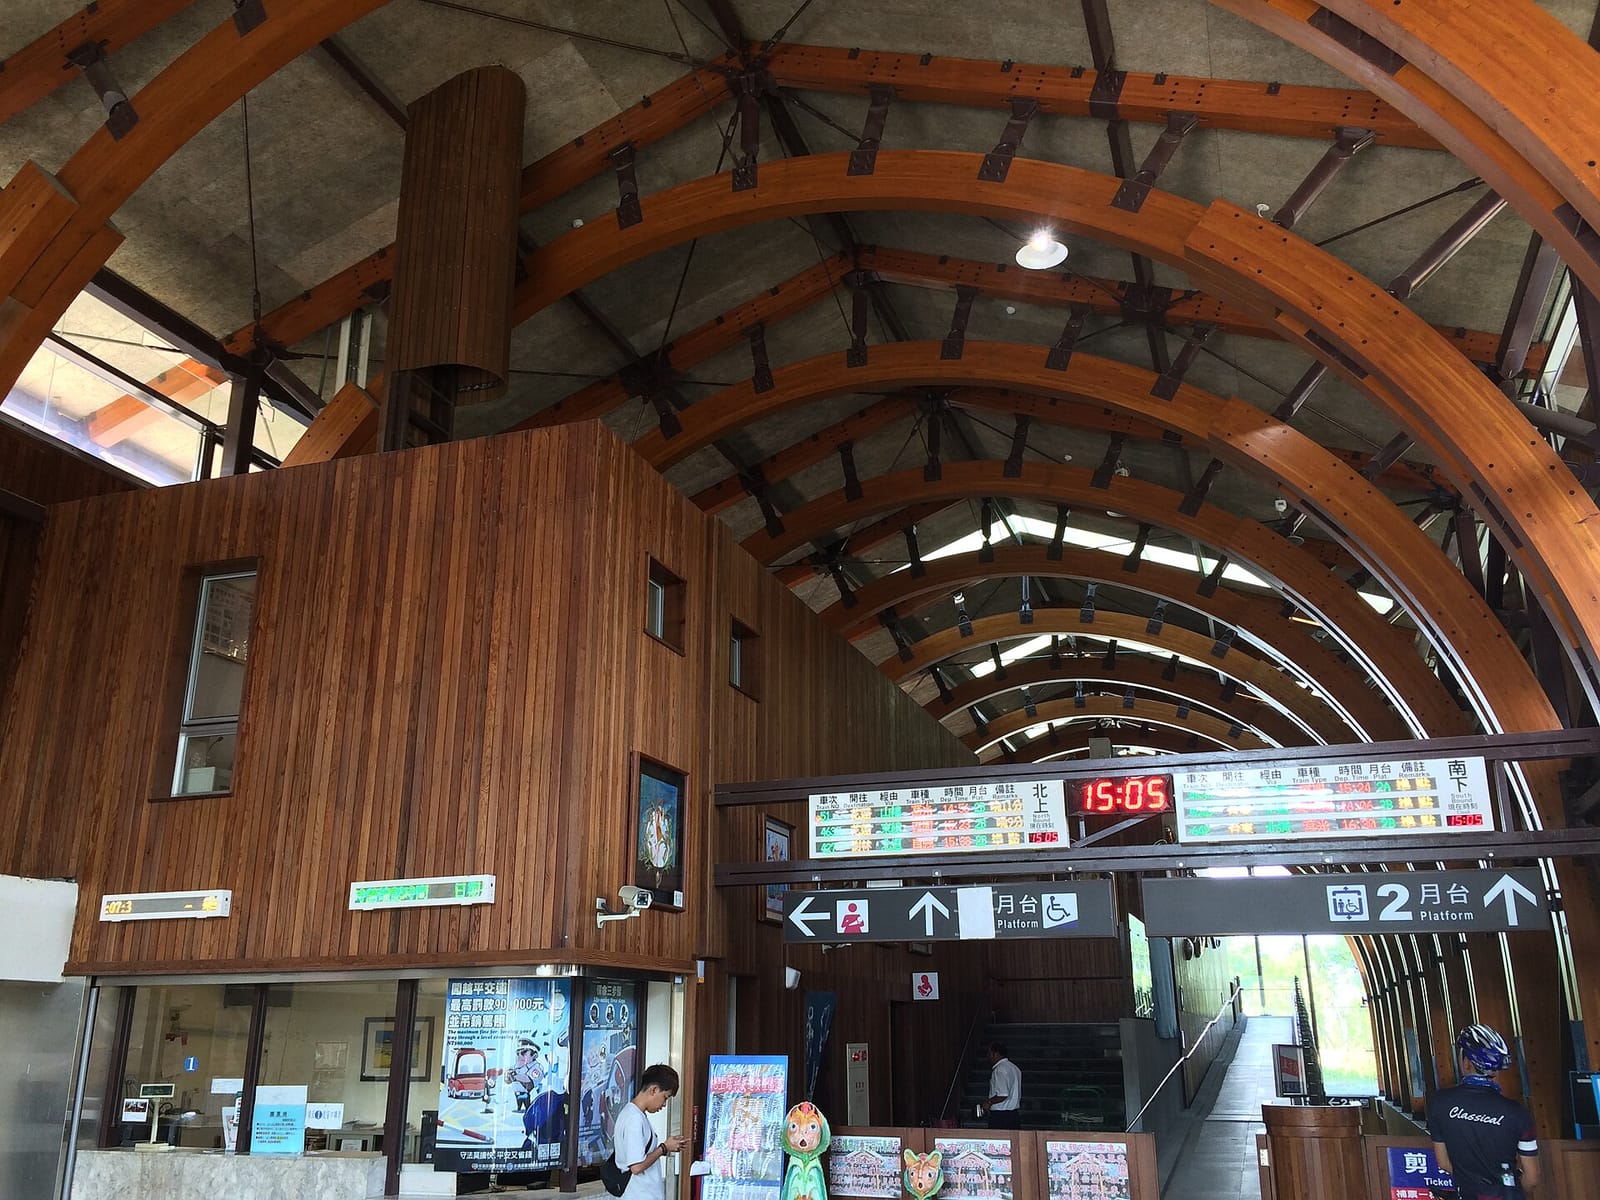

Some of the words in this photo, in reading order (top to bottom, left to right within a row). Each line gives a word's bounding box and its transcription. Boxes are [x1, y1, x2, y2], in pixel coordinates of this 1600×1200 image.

[1223, 772, 1244, 782] 開往
[1260, 769, 1282, 780] 經由
[1297, 767, 1320, 778] 車種
[1339, 765, 1362, 776] 時間
[1369, 763, 1391, 775] 月台
[1401, 761, 1426, 773] 備註
[1312, 776, 1327, 784] Type
[1448, 760, 1467, 793] 南下
[880, 792, 898, 801] 經由
[911, 789, 930, 799] 車種
[944, 786, 964, 797] 時間
[969, 785, 987, 796] 月台
[995, 784, 1015, 794] 備註
[1032, 783, 1048, 813] 北上
[1086, 779, 1165, 811] 15:05
[1450, 815, 1482, 826] 15:05
[997, 894, 1039, 914] 月台
[1376, 883, 1413, 921] 2
[1420, 883, 1470, 905] 月台
[997, 919, 1039, 929] Platform
[1420, 910, 1474, 921] Platform
[187, 1056, 195, 1071] 1
[1449, 1106, 1504, 1126] Classical
[1424, 1177, 1453, 1187] Ticket
